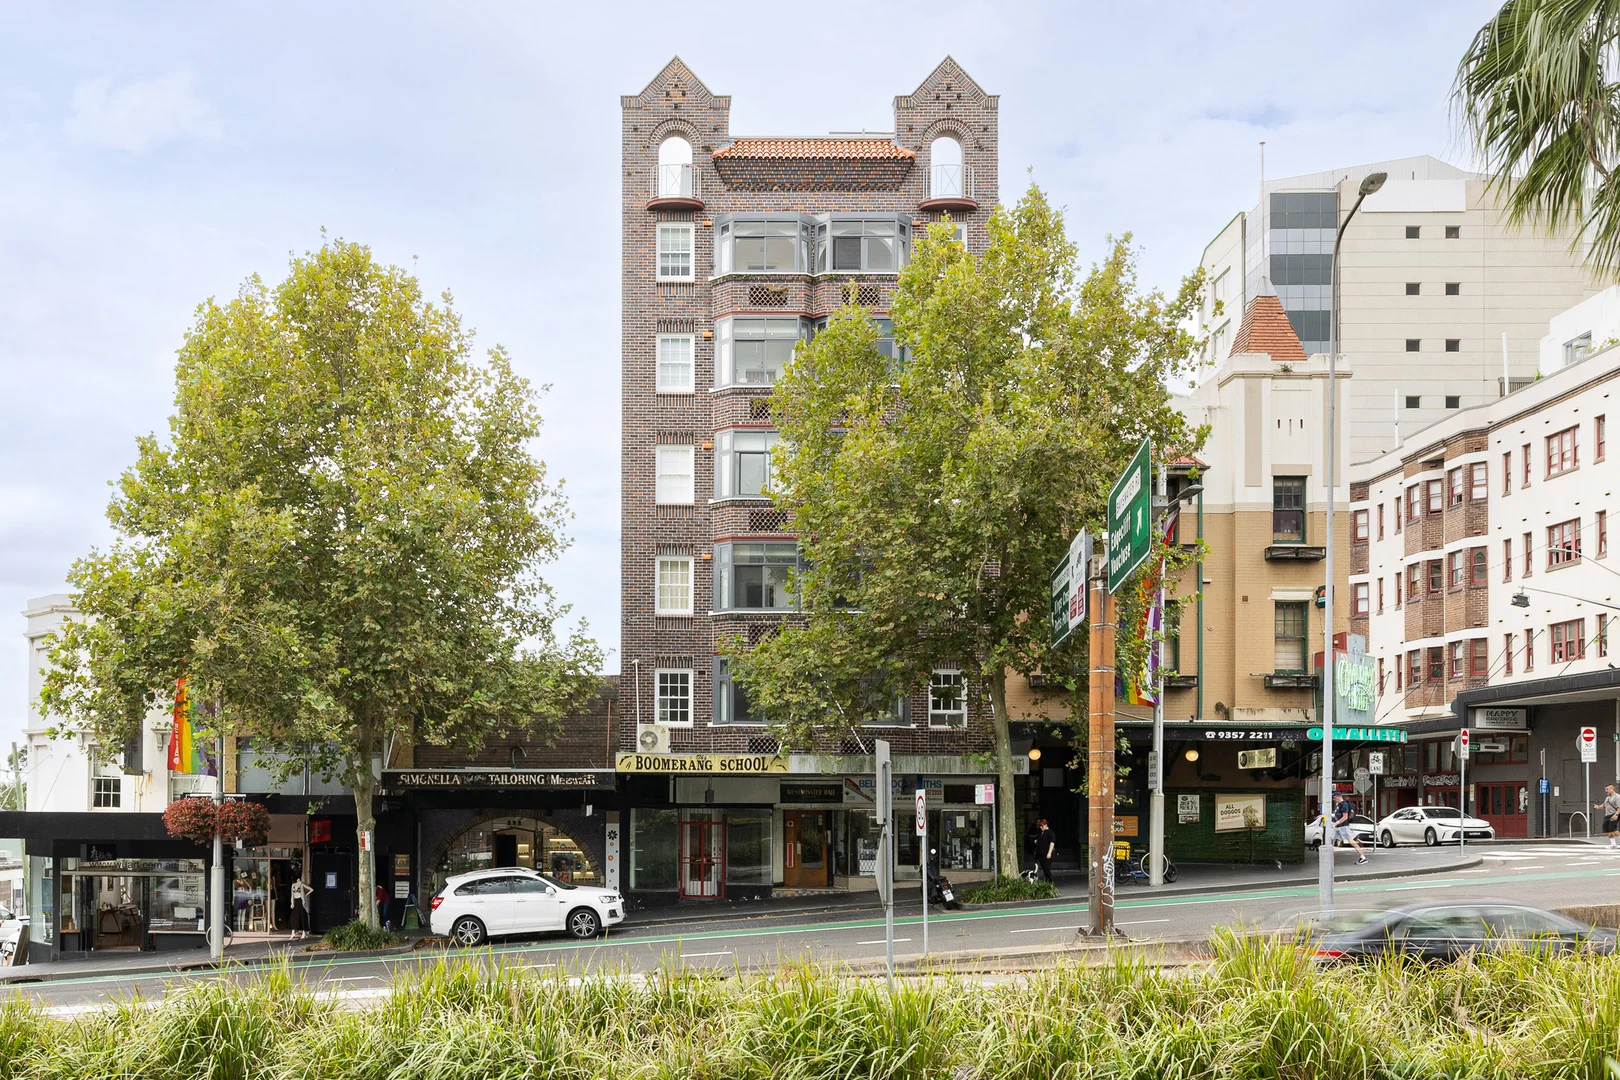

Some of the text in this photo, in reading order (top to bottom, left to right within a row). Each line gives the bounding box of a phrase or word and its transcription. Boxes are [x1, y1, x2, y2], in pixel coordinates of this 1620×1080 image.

[1218, 731, 1245, 739] 9357
[1307, 727, 1401, 742] OMALLEYS
[635, 755, 768, 771] BOOMERANG SCHOOL
[488, 774, 545, 785] TAILORING
[1220, 808, 1241, 816] DOGGOS
